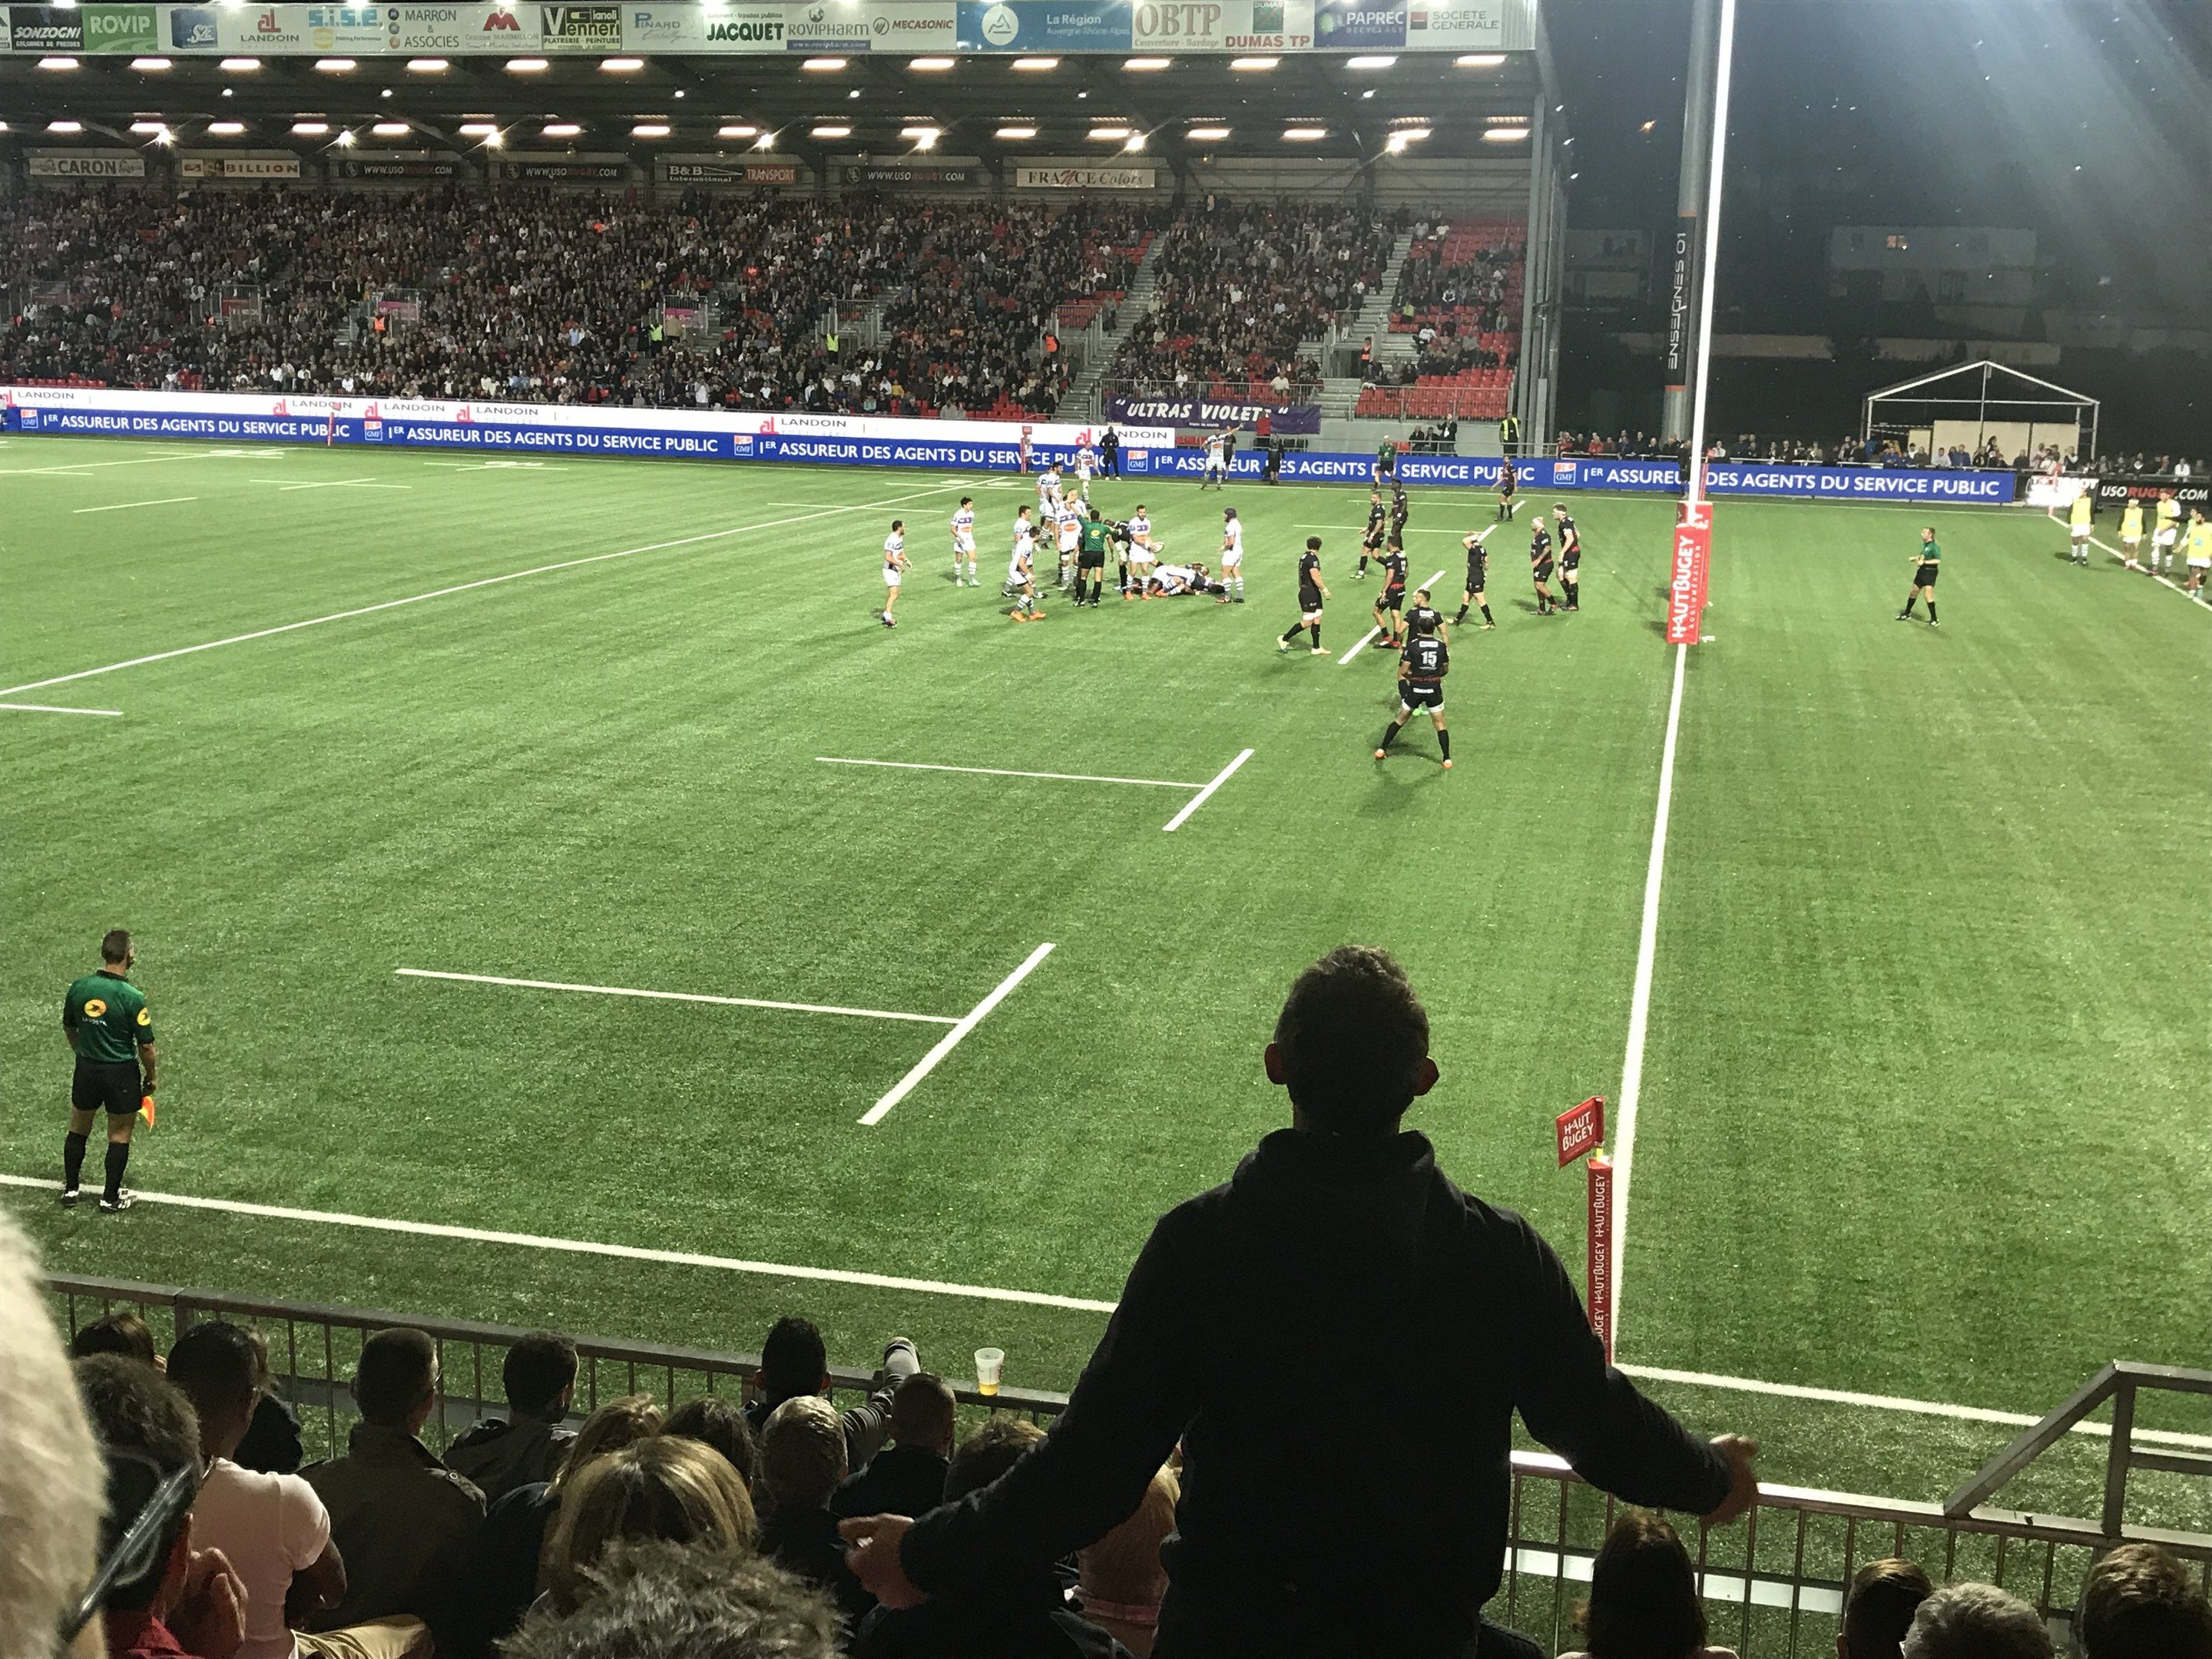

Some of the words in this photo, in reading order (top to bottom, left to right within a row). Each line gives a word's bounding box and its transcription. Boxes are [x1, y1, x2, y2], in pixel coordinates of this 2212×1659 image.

[405, 9, 456, 22] MARRON
[1047, 14, 1060, 25] La
[1062, 13, 1101, 27] Région
[1135, 3, 1221, 37] OBTP
[1346, 12, 1404, 25] PAPREC
[90, 15, 151, 34] ROVIP
[428, 25, 434, 33] &
[14, 26, 81, 38] SONZOGNI
[707, 22, 784, 41] JACQUET
[404, 34, 459, 48] ASSOCIÉS
[1186, 39, 1220, 48] Bardage
[1225, 35, 1285, 48] DUMAS
[1289, 36, 1310, 48] TP
[58, 160, 117, 175] CARON
[226, 164, 298, 173] BILLION
[669, 166, 703, 175] B&B
[746, 169, 795, 180] TRANSPORT
[18, 391, 75, 399] LANDOIN
[385, 403, 445, 412] LANDOIN
[476, 406, 538, 416] LANDOIN
[1127, 402, 1194, 419] ULTRAS
[61, 416, 130, 430] ASSUREUR
[133, 418, 158, 431] DES
[161, 419, 215, 432] AGENTS
[219, 421, 239, 433] DU
[243, 422, 297, 435] SERVICE
[781, 419, 847, 428] LANDOIN
[407, 428, 480, 442] ASSUREUR
[485, 431, 512, 444] DES
[515, 432, 573, 446] AGENTS
[577, 435, 599, 448] DU
[603, 435, 661, 450] SERVICE
[666, 438, 717, 452] PUBLIC
[1098, 430, 1167, 439] LNDOIN
[736, 445, 751, 453] GMF
[780, 443, 858, 458] ASSUREUR
[863, 446, 891, 459] DES
[894, 447, 955, 462] AGENTS
[961, 449, 984, 463] DU
[988, 450, 1050, 465] SERVCE
[1299, 461, 1366, 476] AGENTS
[1402, 464, 1469, 478] SERVICE
[1555, 472, 1573, 482] GMF
[1706, 472, 1738, 485] DES
[1742, 473, 1815, 489] AGENTS
[1821, 476, 1849, 490] DU
[1854, 477, 1928, 493] SERVICE
[1933, 479, 1999, 496] PUBLIC
[1421, 651, 1438, 667] 15
[1564, 1111, 1591, 1135] HAUT
[1562, 1122, 1594, 1152] BUGEY
